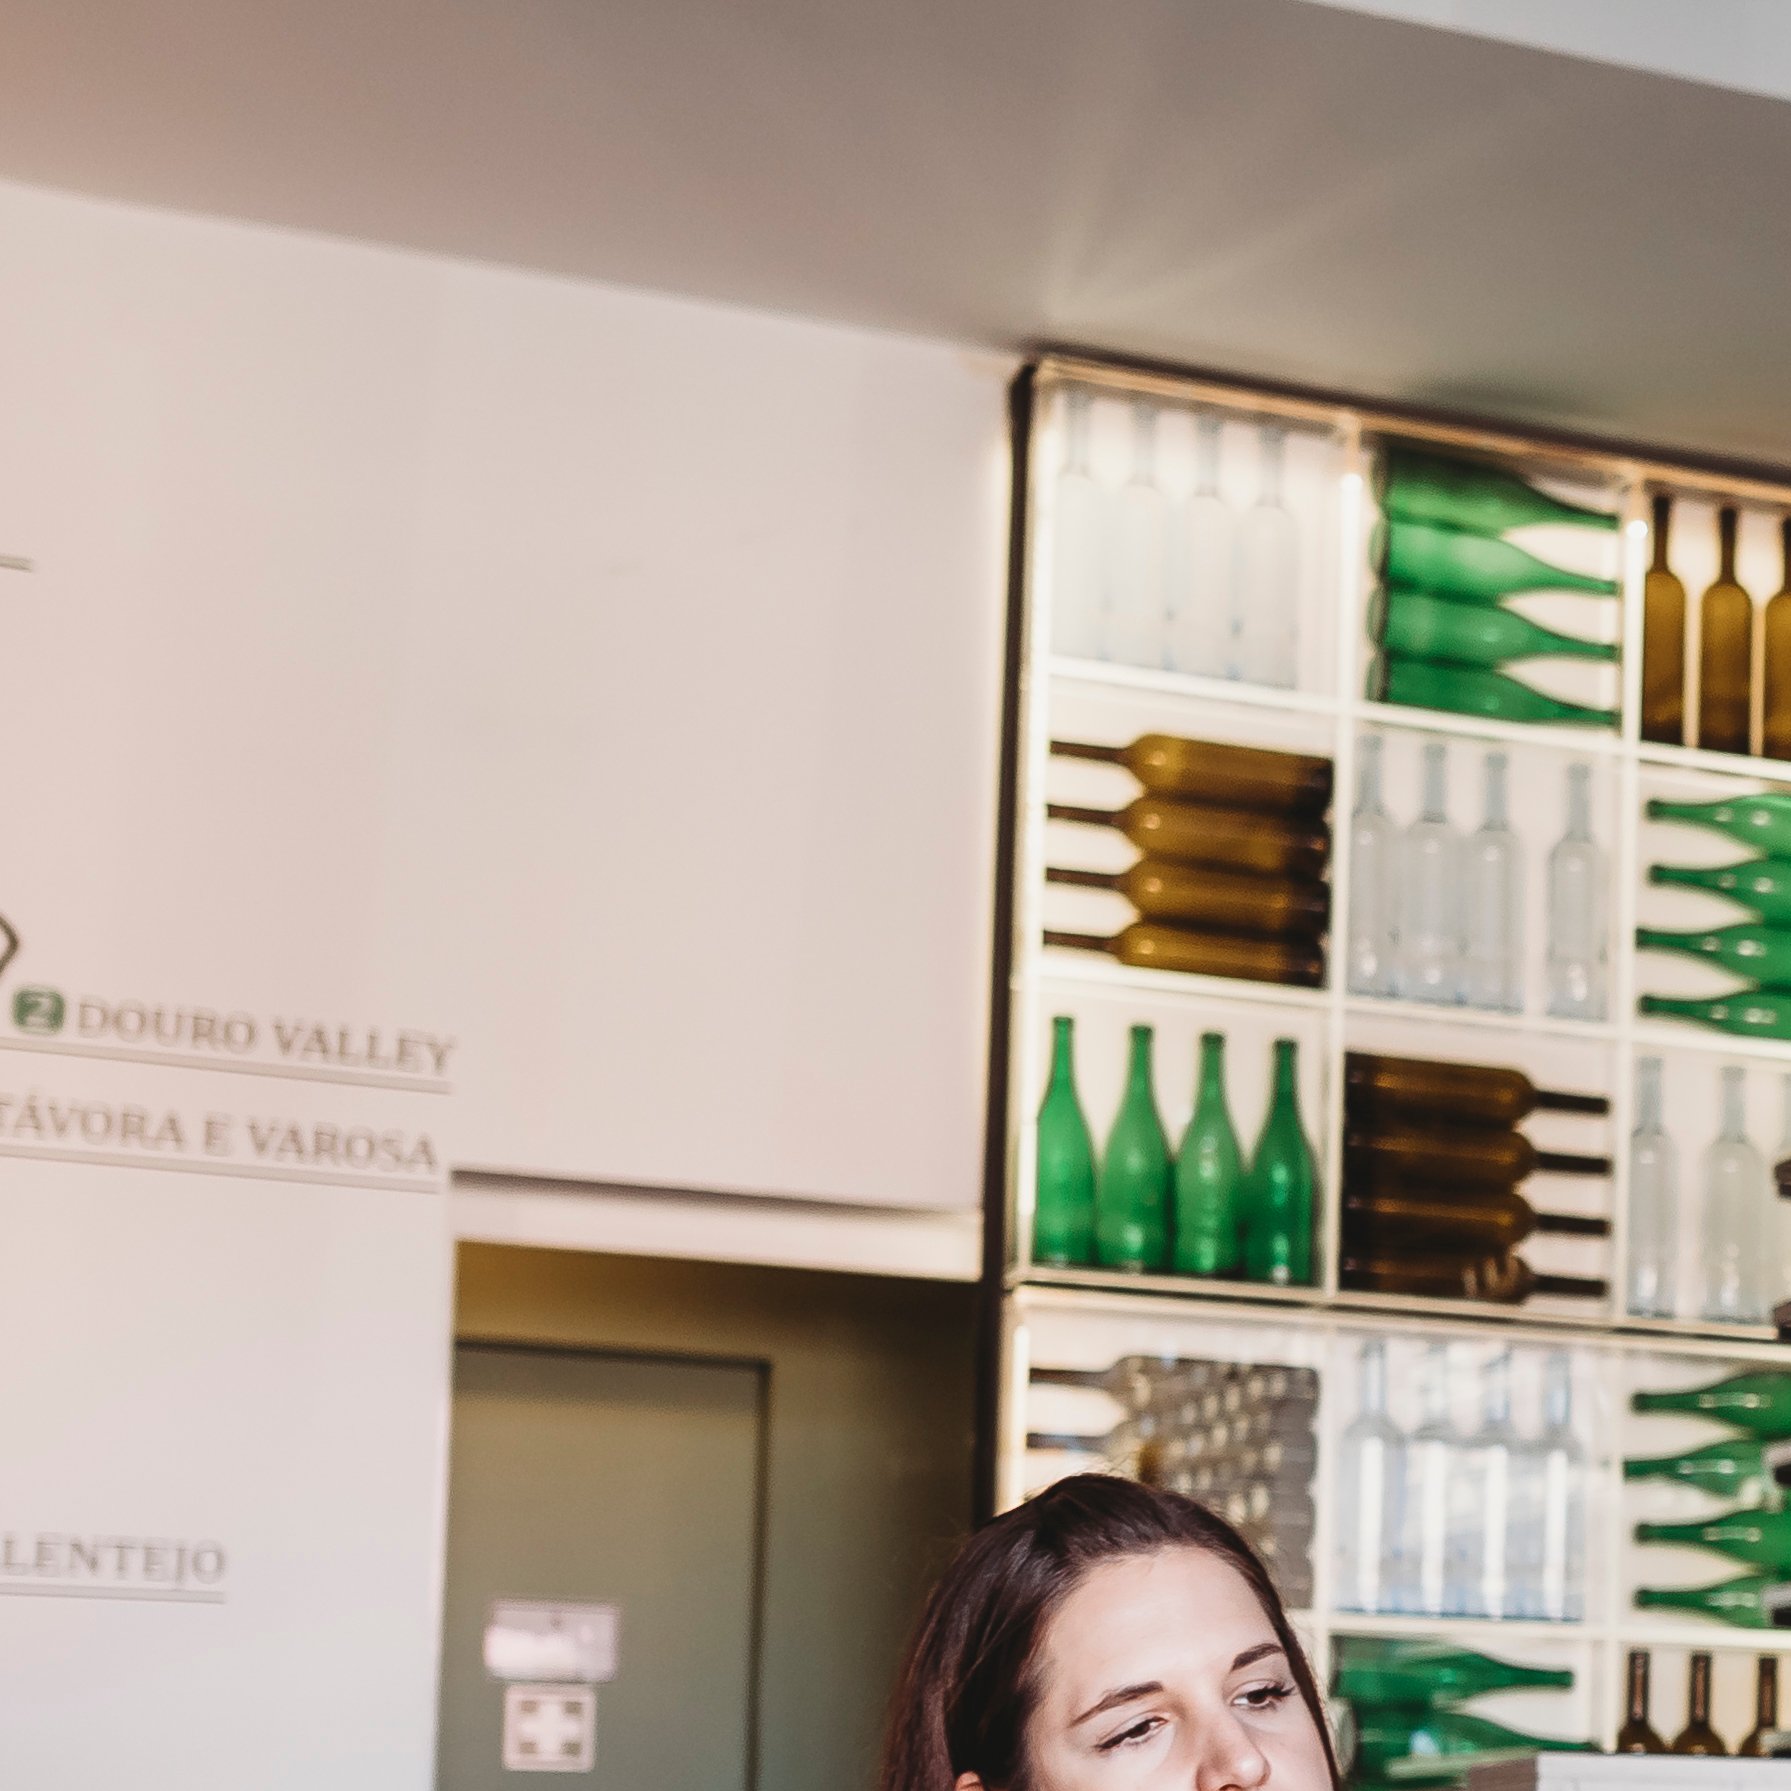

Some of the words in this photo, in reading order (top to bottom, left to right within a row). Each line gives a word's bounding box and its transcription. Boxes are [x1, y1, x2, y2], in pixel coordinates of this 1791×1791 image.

[77, 997, 259, 1053] DOURO
[272, 1016, 457, 1074] VALLEY
[202, 1113, 229, 1156] E
[245, 1117, 440, 1173] VAROSA
[2, 1531, 226, 1589] LENTEJO
